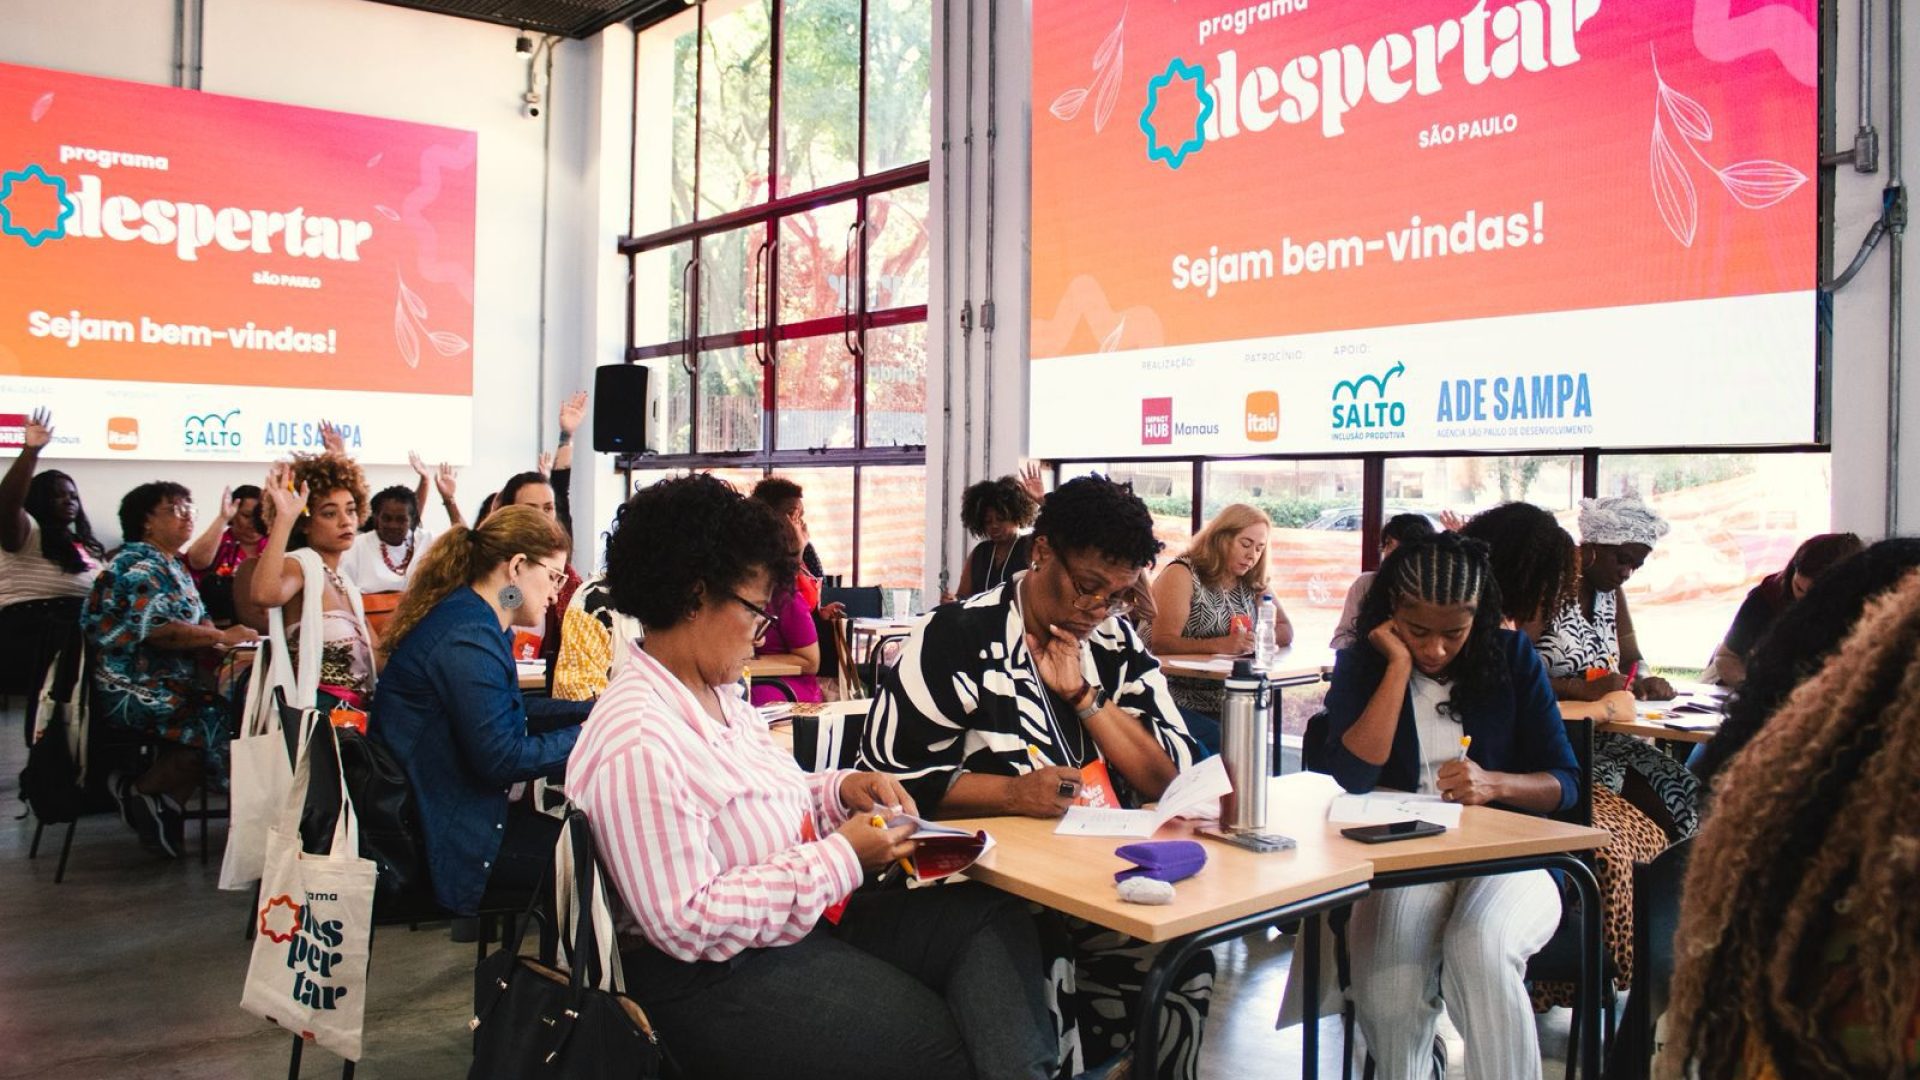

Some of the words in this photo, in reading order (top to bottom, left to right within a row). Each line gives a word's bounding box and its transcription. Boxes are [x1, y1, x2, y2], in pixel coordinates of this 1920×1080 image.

[1202, 0, 1602, 141] despertar
[1418, 123, 1455, 148] SÃO
[1458, 113, 1518, 141] PAULO
[59, 145, 169, 170] programa
[61, 174, 373, 261] despertar
[1172, 245, 1273, 297] Sejam
[1282, 200, 1544, 276] bem-vindas!
[252, 270, 280, 286] SÃO
[281, 273, 321, 288] PAULO
[29, 310, 134, 347] Sejam
[141, 316, 336, 354] bem-vindas!
[1437, 378, 1487, 422] ADE
[1494, 372, 1592, 421] SAMPA
[1174, 422, 1219, 435] Manaus
[1332, 402, 1405, 428] SALTO
[185, 430, 241, 446] SALTO
[265, 422, 298, 446] ADE
[303, 422, 362, 447] SAPA
[1145, 423, 1170, 438] HUB
[1365, 431, 1405, 439] PRODUTIVA
[287, 933, 343, 978] per
[293, 971, 347, 1009] tar
